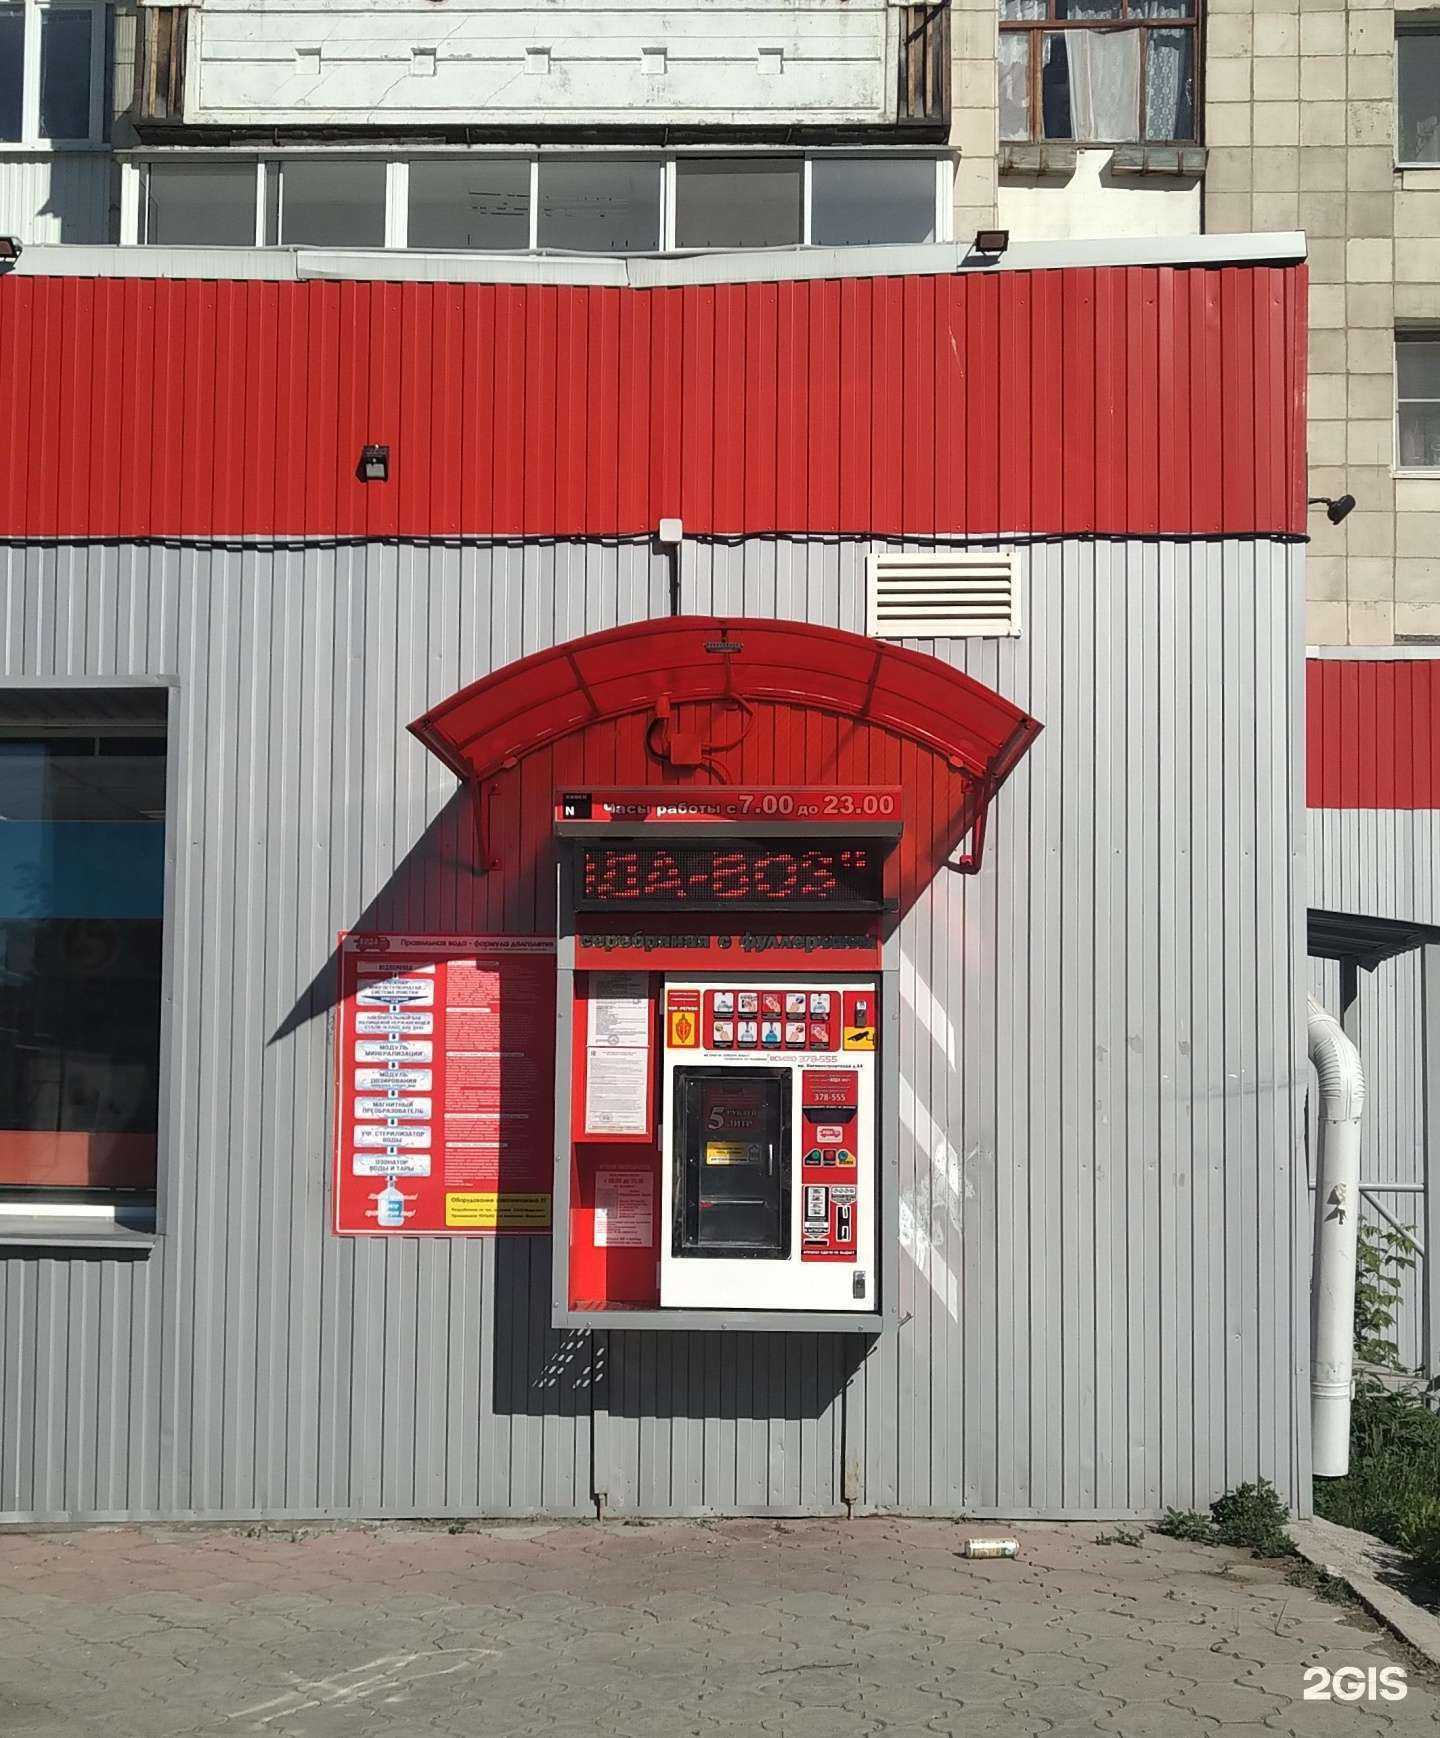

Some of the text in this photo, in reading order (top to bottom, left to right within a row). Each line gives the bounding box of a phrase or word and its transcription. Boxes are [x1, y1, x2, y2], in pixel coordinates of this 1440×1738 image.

[603, 795, 894, 817] Часы работы с 7.00 до 23.00
[813, 1093, 846, 1101] 378-555
